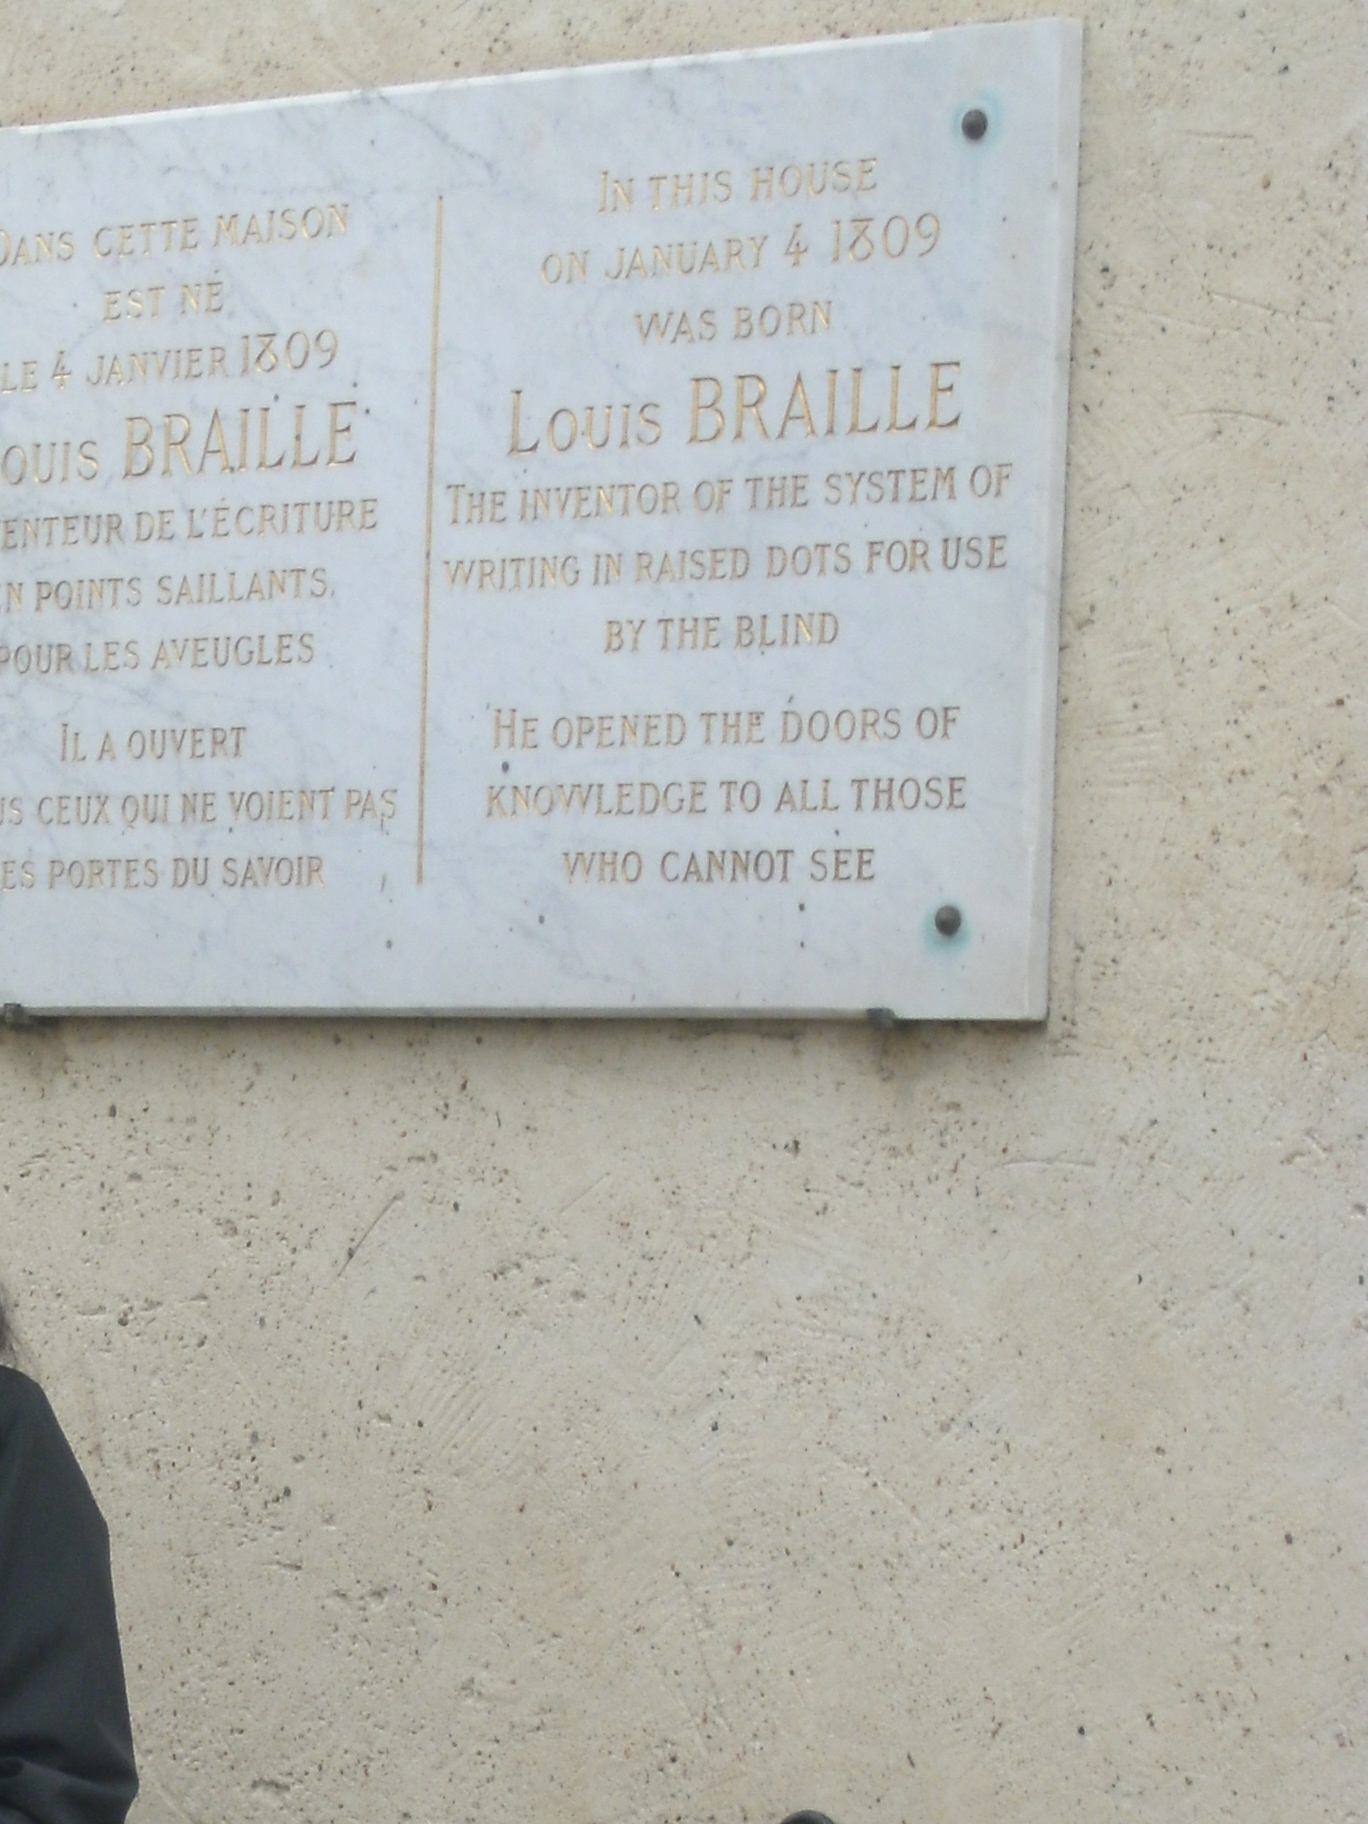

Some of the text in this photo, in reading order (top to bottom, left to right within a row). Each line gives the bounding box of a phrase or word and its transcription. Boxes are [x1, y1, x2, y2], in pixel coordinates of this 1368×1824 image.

[649, 171, 731, 211] THIS
[751, 158, 877, 201] HOUSE
[93, 218, 199, 260] CETTE
[213, 204, 350, 248] MAISON
[541, 213, 941, 284] ON JANUARY 4 1809
[103, 270, 223, 322] EST NÉ
[635, 302, 832, 345] WAS BORN
[2, 330, 339, 393] LE 4 JANVIER 1809
[687, 361, 962, 445] BRAILLE
[122, 401, 358, 480] BRAILLE
[519, 482, 680, 521] INVENTOR
[694, 480, 733, 513] OF
[745, 475, 809, 510] THE
[824, 467, 956, 507] SYSTEM
[969, 463, 1013, 498] OF
[135, 508, 175, 543] DE
[188, 498, 378, 539] L'ÉCRITURE
[442, 536, 1007, 591] WRITING IN RAISED DOTS FOR USE
[35, 577, 141, 612] POINTS
[85, 640, 140, 671] LES
[152, 634, 315, 668] AVEUGLES
[604, 612, 839, 654] BY THE BLIND
[99, 731, 115, 760] A
[128, 726, 246, 760] OUVERT
[552, 714, 687, 748] OPENED
[700, 711, 765, 745] THE
[781, 710, 901, 744] DOORS
[915, 707, 961, 741] OF
[37, 797, 110, 826] CEUX
[122, 794, 168, 829] QUI
[182, 791, 216, 824] NE
[230, 786, 335, 822] VOIENT
[345, 789, 397, 820] PAS
[485, 777, 966, 818] KNOWLEDGE TO ALL THOSE
[48, 859, 158, 889] PORTES
[172, 858, 209, 888] DU
[222, 856, 324, 888] SAVOIR
[562, 848, 875, 884] WHO CANNOT SEE
